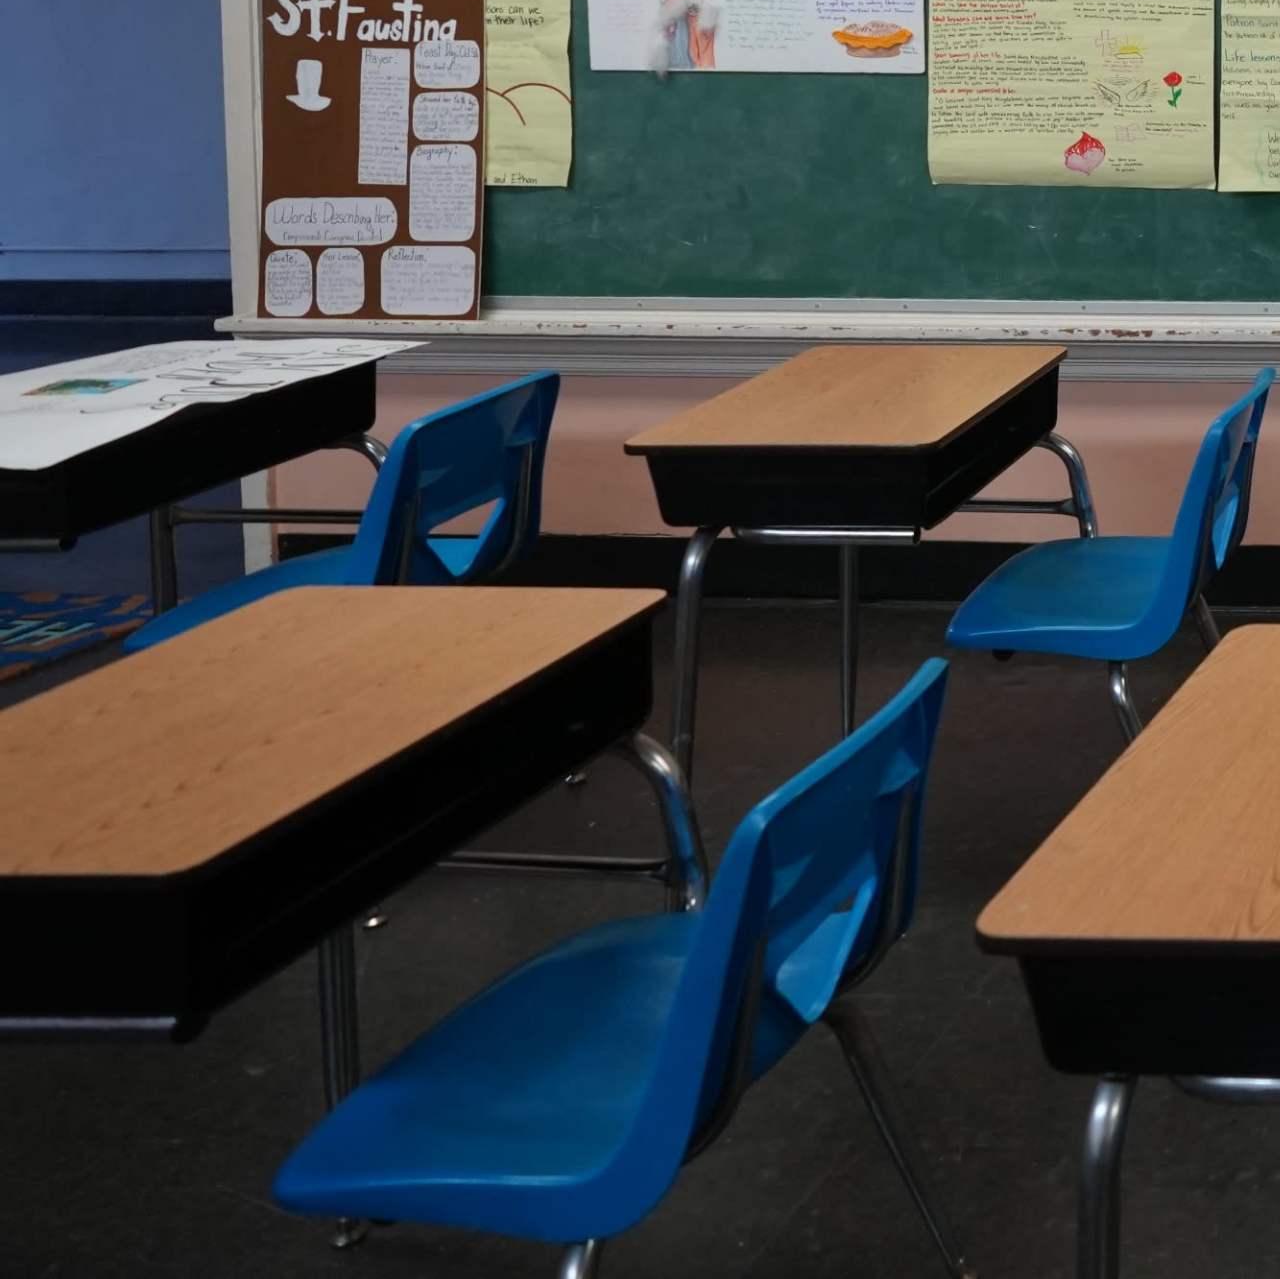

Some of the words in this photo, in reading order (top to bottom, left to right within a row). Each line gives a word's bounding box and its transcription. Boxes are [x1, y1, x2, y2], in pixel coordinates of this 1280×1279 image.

[508, 5, 524, 14] can
[528, 5, 541, 14] we
[496, 16, 514, 24] their
[520, 16, 544, 26] life?
[419, 45, 441, 59] Feast
[1224, 48, 1248, 62] Life
[511, 174, 537, 185] Ethan
[273, 204, 318, 225] Words
